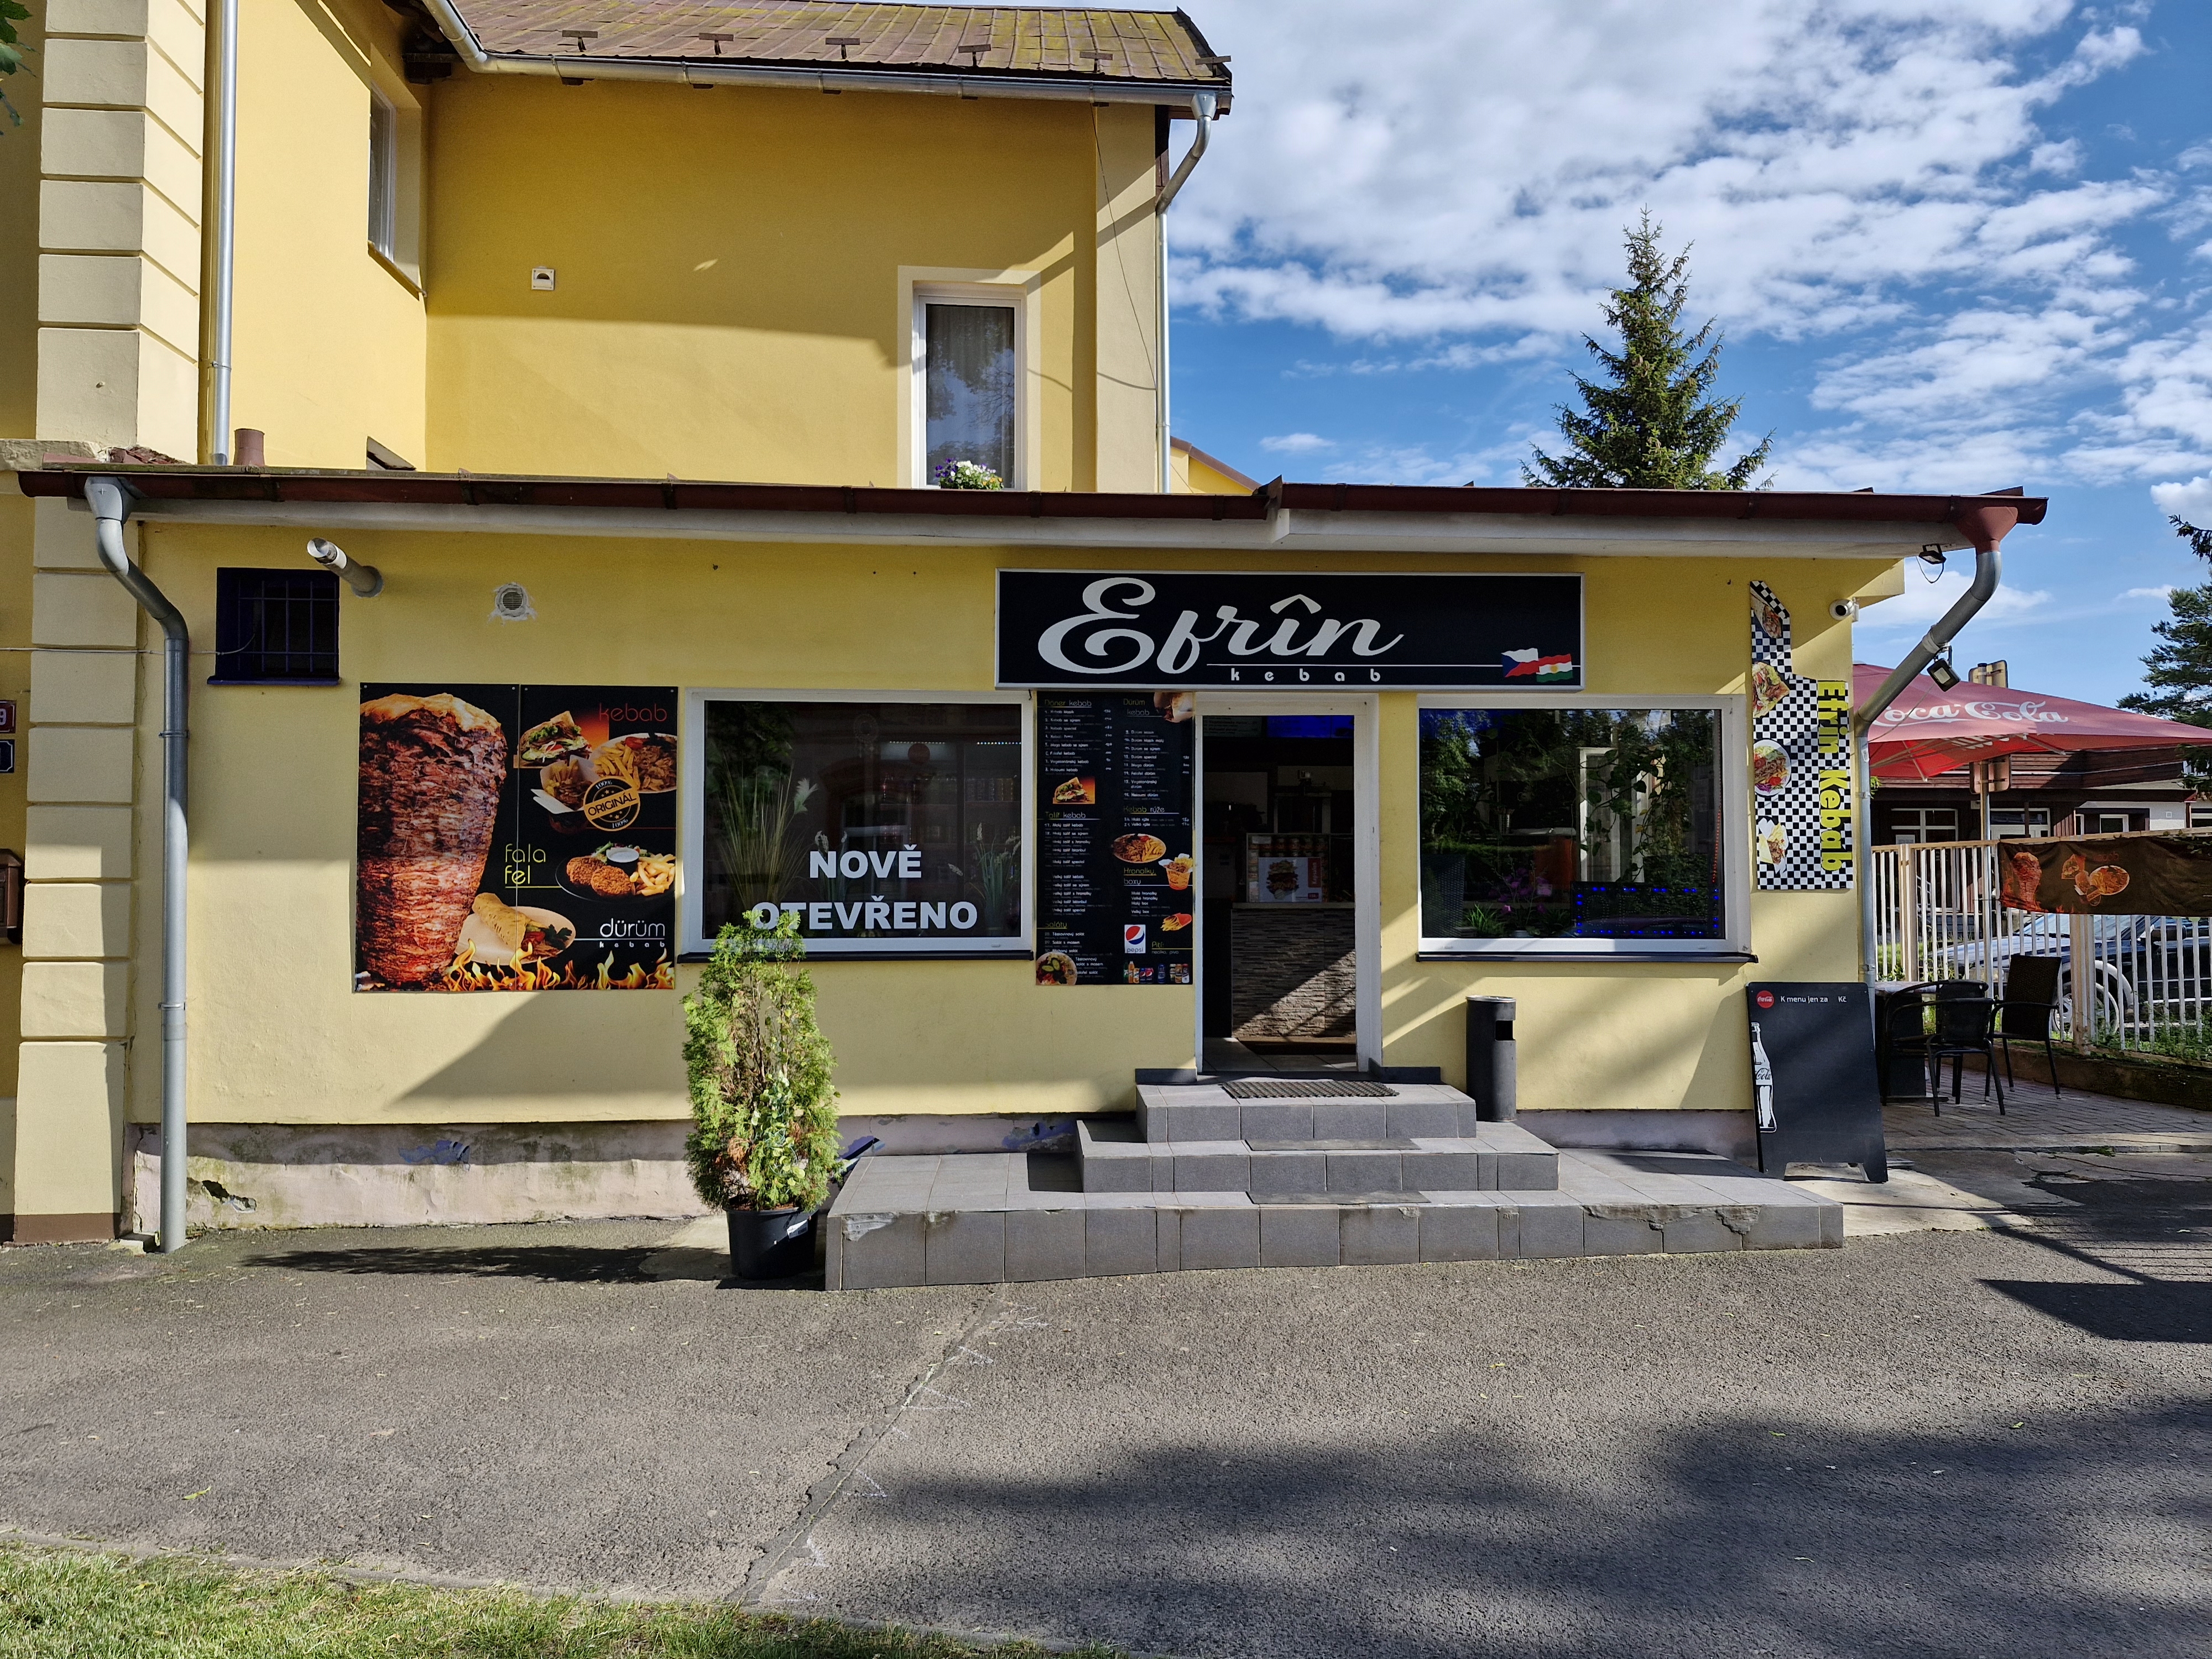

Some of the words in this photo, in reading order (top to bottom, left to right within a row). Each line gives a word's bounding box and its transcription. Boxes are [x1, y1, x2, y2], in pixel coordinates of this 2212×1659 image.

[1037, 577, 1405, 674] Efrîn
[1231, 668, 1381, 681] kebab
[599, 702, 667, 722] kebab
[1817, 681, 1849, 753] Efrin
[595, 780, 613, 790] 100%
[588, 792, 637, 816] ORIGINÁL
[612, 819, 629, 828] 100%
[1819, 770, 1852, 870] Kebab
[505, 843, 546, 863] fala
[810, 844, 922, 878] NOVĚ
[505, 865, 530, 885] fel
[751, 895, 978, 930] OTEVŘENO
[600, 917, 665, 937] dürüm
